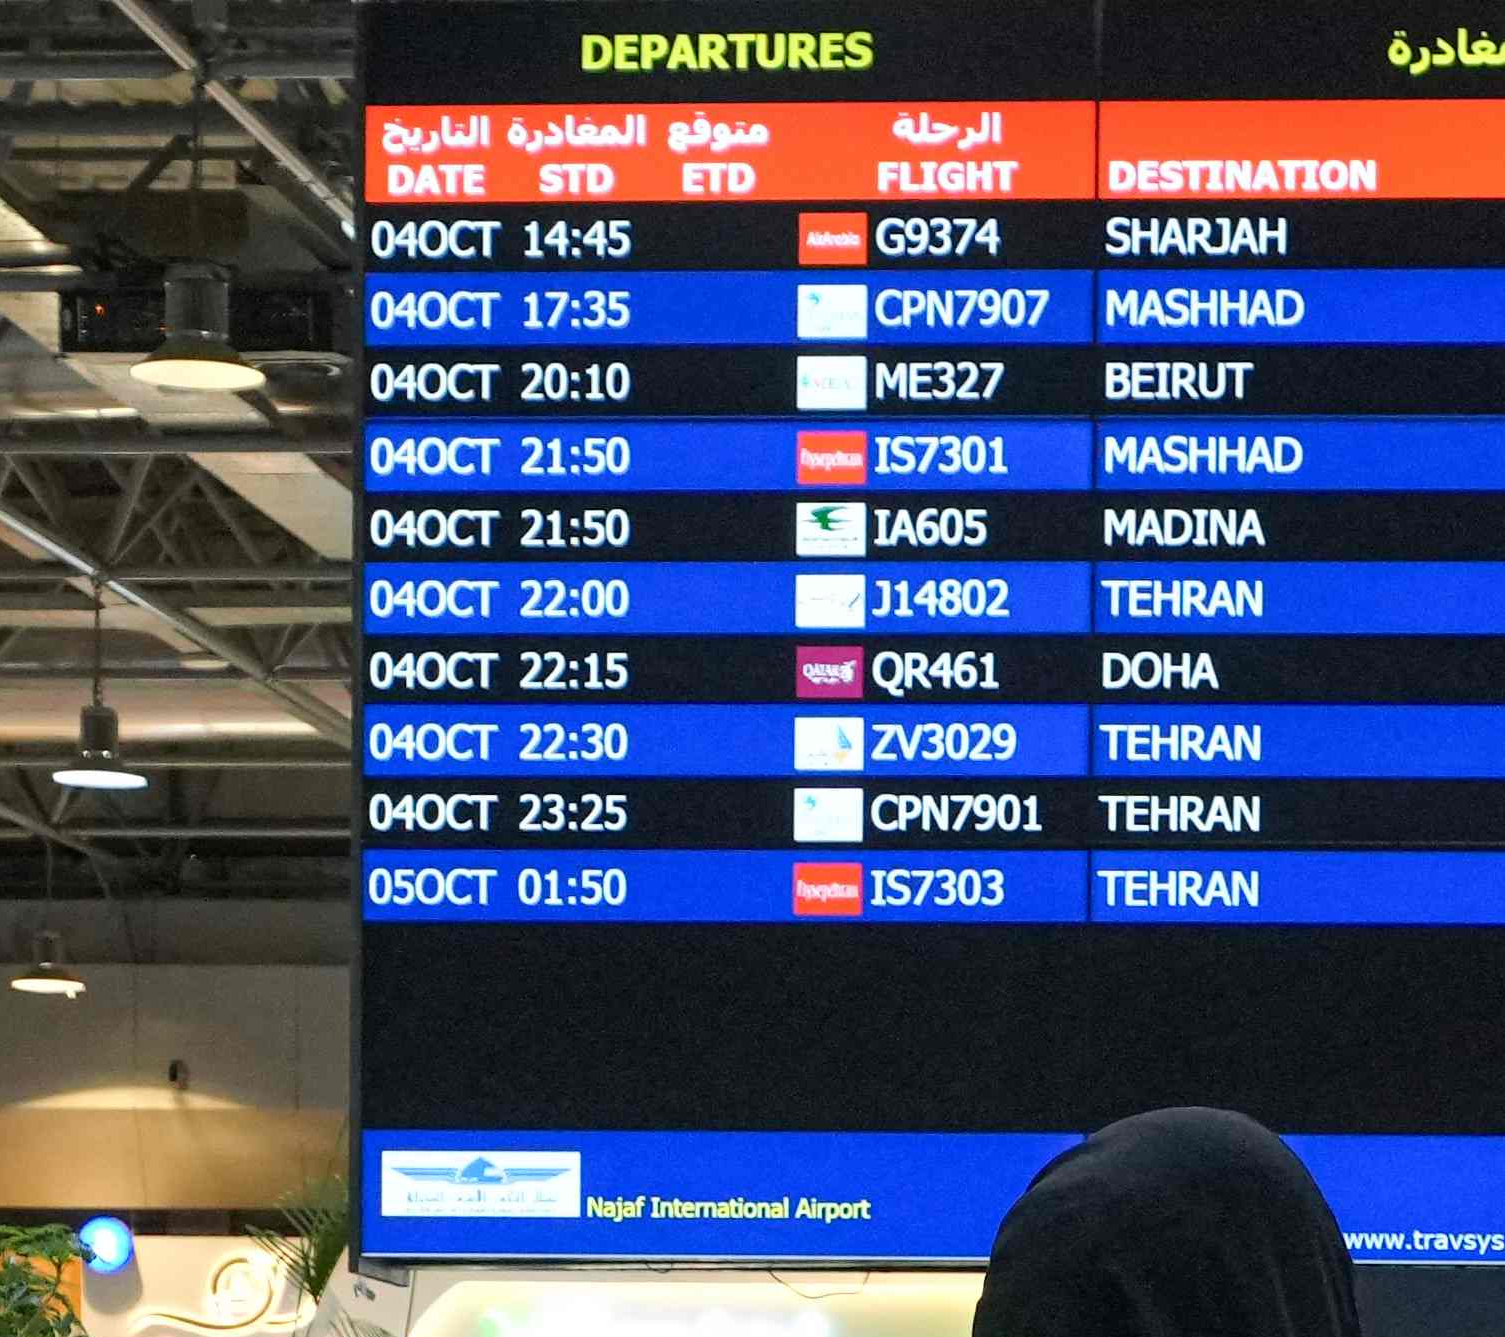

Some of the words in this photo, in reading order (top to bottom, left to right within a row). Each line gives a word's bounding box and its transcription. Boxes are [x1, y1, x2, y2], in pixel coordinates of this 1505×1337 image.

[581, 31, 873, 71] DEPARTURES
[382, 115, 491, 154] التاريخ
[506, 113, 648, 153] المغادرة
[667, 111, 771, 153] متوقع
[891, 111, 1003, 151] الرحلة
[387, 163, 486, 197] DATE
[539, 163, 616, 195] STD
[682, 162, 757, 195] ETD
[877, 160, 1020, 194] FLIGHT
[1108, 159, 1377, 193] DESTINATION
[371, 219, 502, 259] 04OCT
[524, 219, 631, 258] 14:45
[875, 217, 1001, 256] G9374
[1105, 216, 1287, 256] SHARJAH
[370, 290, 501, 330] 04OCT
[523, 289, 630, 330] 17:35
[874, 288, 1050, 327] CPN7907
[1105, 287, 1305, 327] MASHHAD
[370, 362, 501, 402] 04OCT
[520, 362, 631, 401] 20:10
[875, 361, 1005, 400] ME327
[1105, 361, 1254, 400] BEIRUT
[370, 436, 501, 476] 04OCT
[520, 436, 631, 475] 21:50
[874, 435, 1008, 474] IS7301
[1104, 434, 1303, 474] MASHHAD
[370, 508, 500, 547] 04OCT
[520, 508, 630, 547] 21:50
[873, 507, 988, 546] IA605
[1104, 508, 1266, 546] MADINA
[369, 579, 500, 618] 04OCT
[519, 579, 630, 618] 22:00
[871, 578, 1010, 617] J14802
[1100, 579, 1263, 617] TEHRAN
[369, 651, 500, 690] 04OCT
[519, 651, 628, 690] 22:15
[871, 650, 1000, 697] QR461
[1102, 651, 1219, 689] DOHA
[369, 722, 499, 761] 04OCT
[518, 722, 628, 761] 22:30
[870, 722, 1017, 761] ZV3029
[1098, 724, 1261, 761] TEHRAN
[368, 793, 499, 831] 04OCT
[518, 793, 627, 831] 23:25
[870, 793, 1043, 832] CPN7901
[1097, 795, 1261, 832] TEHRAN
[368, 867, 498, 906] 05OCT
[517, 868, 627, 906] 01:50
[870, 868, 1005, 907] IS7303
[1096, 870, 1259, 907] TEHRAN
[586, 1195, 646, 1223] Najaf
[650, 1196, 790, 1219] International
[794, 1197, 872, 1224] Airport
